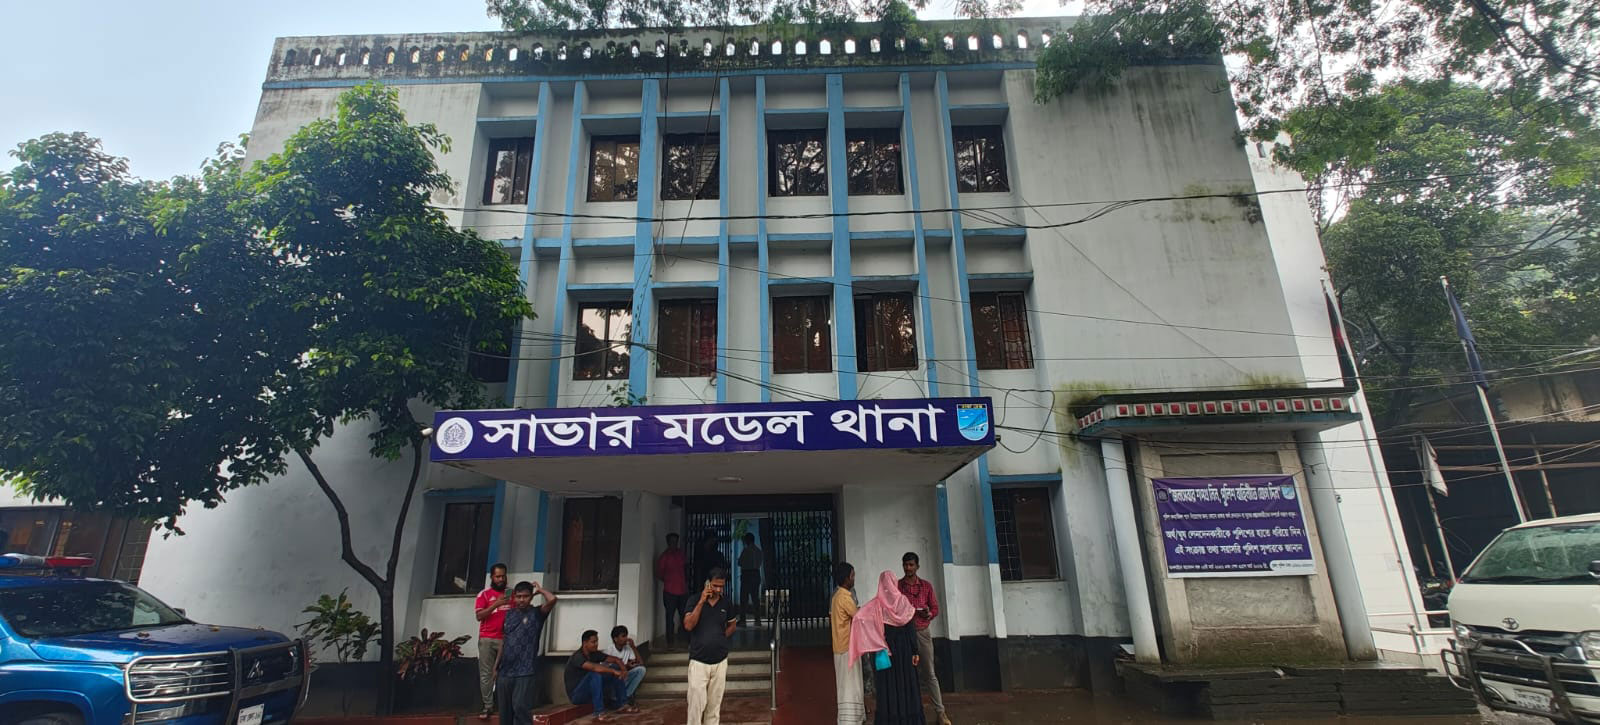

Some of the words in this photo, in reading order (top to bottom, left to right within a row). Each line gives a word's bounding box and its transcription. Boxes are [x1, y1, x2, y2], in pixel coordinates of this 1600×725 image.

[480, 412, 644, 453] সাভার
[654, 411, 813, 453] মডেল
[829, 403, 946, 451] থানা
